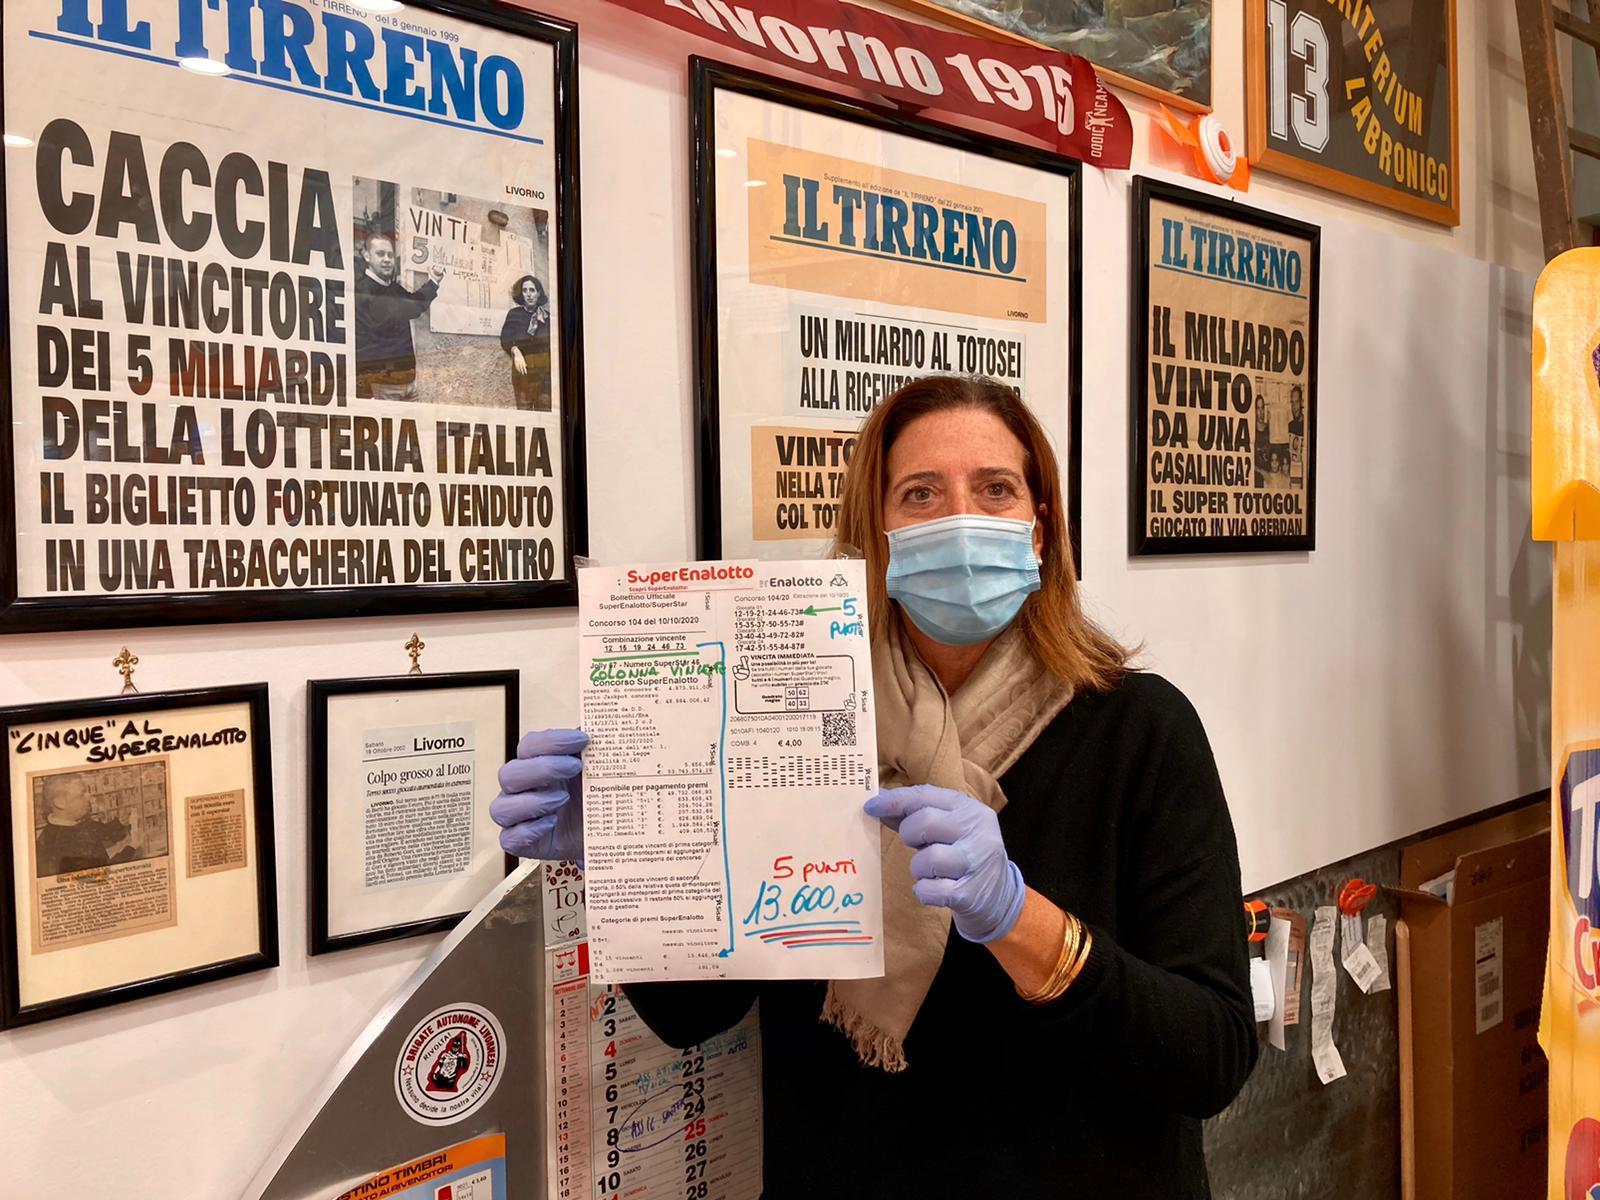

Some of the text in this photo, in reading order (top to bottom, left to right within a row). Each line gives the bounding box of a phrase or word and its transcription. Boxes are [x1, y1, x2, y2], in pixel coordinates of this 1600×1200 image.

[375, 14, 390, 24] del
[391, 17, 398, 27] 8
[400, 21, 437, 37] gennaio
[440, 30, 459, 43] 1999
[174, 0, 524, 131] TIRRENO
[664, 0, 1075, 136] ivorno 1915
[1268, 0, 1330, 153] 13
[1328, 0, 1424, 136] ITERIUM
[1345, 77, 1449, 201] LABRONICO
[36, 118, 345, 271] CACCIA
[505, 185, 545, 200] LIVORNO
[783, 173, 1017, 274] IL TIRRENO
[412, 236, 429, 265] 5
[1162, 218, 1187, 269] IL
[1190, 225, 1302, 293] TIRRENO
[38, 242, 347, 344] AL VINCITORE
[800, 315, 1022, 378] UN MILIARDO AL TOTOSEI
[1153, 304, 1305, 376] IL MILIARDO
[37, 325, 347, 408] DEI 5 MILIARDI
[800, 366, 840, 410] ALLA
[1152, 362, 1252, 414] VINTO
[41, 396, 553, 477] DELLA LOTTERIA ITALIA
[1152, 409, 1252, 453] DA UNA
[775, 435, 858, 467] VINTO
[1151, 450, 1251, 487] CASALINGA?
[776, 471, 824, 499] NELLA
[41, 471, 554, 528] IL BIGLIETTO FORTUNATO VENDUTO
[1151, 490, 1303, 515] IL SUPER TOTOGOL
[776, 503, 808, 530] COL
[1151, 517, 1302, 537] GIOCATO IN VIA OBERDAN
[46, 537, 555, 592] IN UNA TABACCHERIA DEL CENTRO
[627, 566, 754, 585] SuperEnalotto
[770, 577, 823, 587] Enalotto
[843, 597, 857, 616] 5
[589, 619, 626, 627] Concorso
[629, 618, 642, 626] 104
[659, 617, 699, 625] 10/10/2020
[602, 635, 654, 644] Combinazione
[590, 664, 660, 682] COLONNA
[624, 660, 652, 668] Numero
[593, 676, 698, 687] Concorso SuperEnalotto
[787, 689, 796, 697] 50
[121, 720, 162, 738] AL
[87, 727, 247, 763] SUPERENALOTTO
[414, 737, 466, 751] Livorno
[785, 739, 802, 747] 4,00
[367, 763, 471, 786] Colpo grosso al Lotto
[590, 782, 709, 793] Disponibile per pagamento premi
[773, 856, 794, 879] 5
[743, 880, 864, 925] 13.600,00
[560, 1009, 566, 1017] 2
[561, 998, 565, 1006] 1
[604, 997, 616, 1015] 2
[604, 1019, 616, 1037] 3
[406, 1025, 435, 1061] BRIGATE
[436, 1013, 480, 1029] AUTONOME
[479, 1024, 496, 1067] LIVORNESI
[423, 1032, 452, 1061] RIVOLTA!
[560, 1043, 566, 1051] 5
[604, 1040, 617, 1057] 4
[561, 1065, 567, 1073] 7
[605, 1062, 617, 1080] 5
[682, 1056, 704, 1077] 22
[561, 1076, 567, 1084] 8
[683, 1077, 704, 1099] 23
[419, 1101, 439, 1113] decide
[449, 1097, 470, 1111] nostra
[471, 1083, 484, 1098] vita!
[558, 1100, 568, 1108] 10
[605, 1084, 618, 1102] 6
[558, 1110, 567, 1119] 11
[606, 1105, 618, 1124] 7
[684, 1099, 705, 1120] 24
[558, 1121, 568, 1130] 12
[684, 1118, 706, 1141] 25
[558, 1133, 569, 1141] 13
[607, 1128, 619, 1146] 8
[607, 1150, 619, 1168] 9
[685, 1140, 707, 1162] 26
[336, 1153, 447, 1200] STINO TIMBRI
[379, 1163, 454, 1197] AI RIVENDITORI
[686, 1160, 707, 1183] 27
[598, 1172, 621, 1194] 10
[686, 1181, 708, 1200] 28
